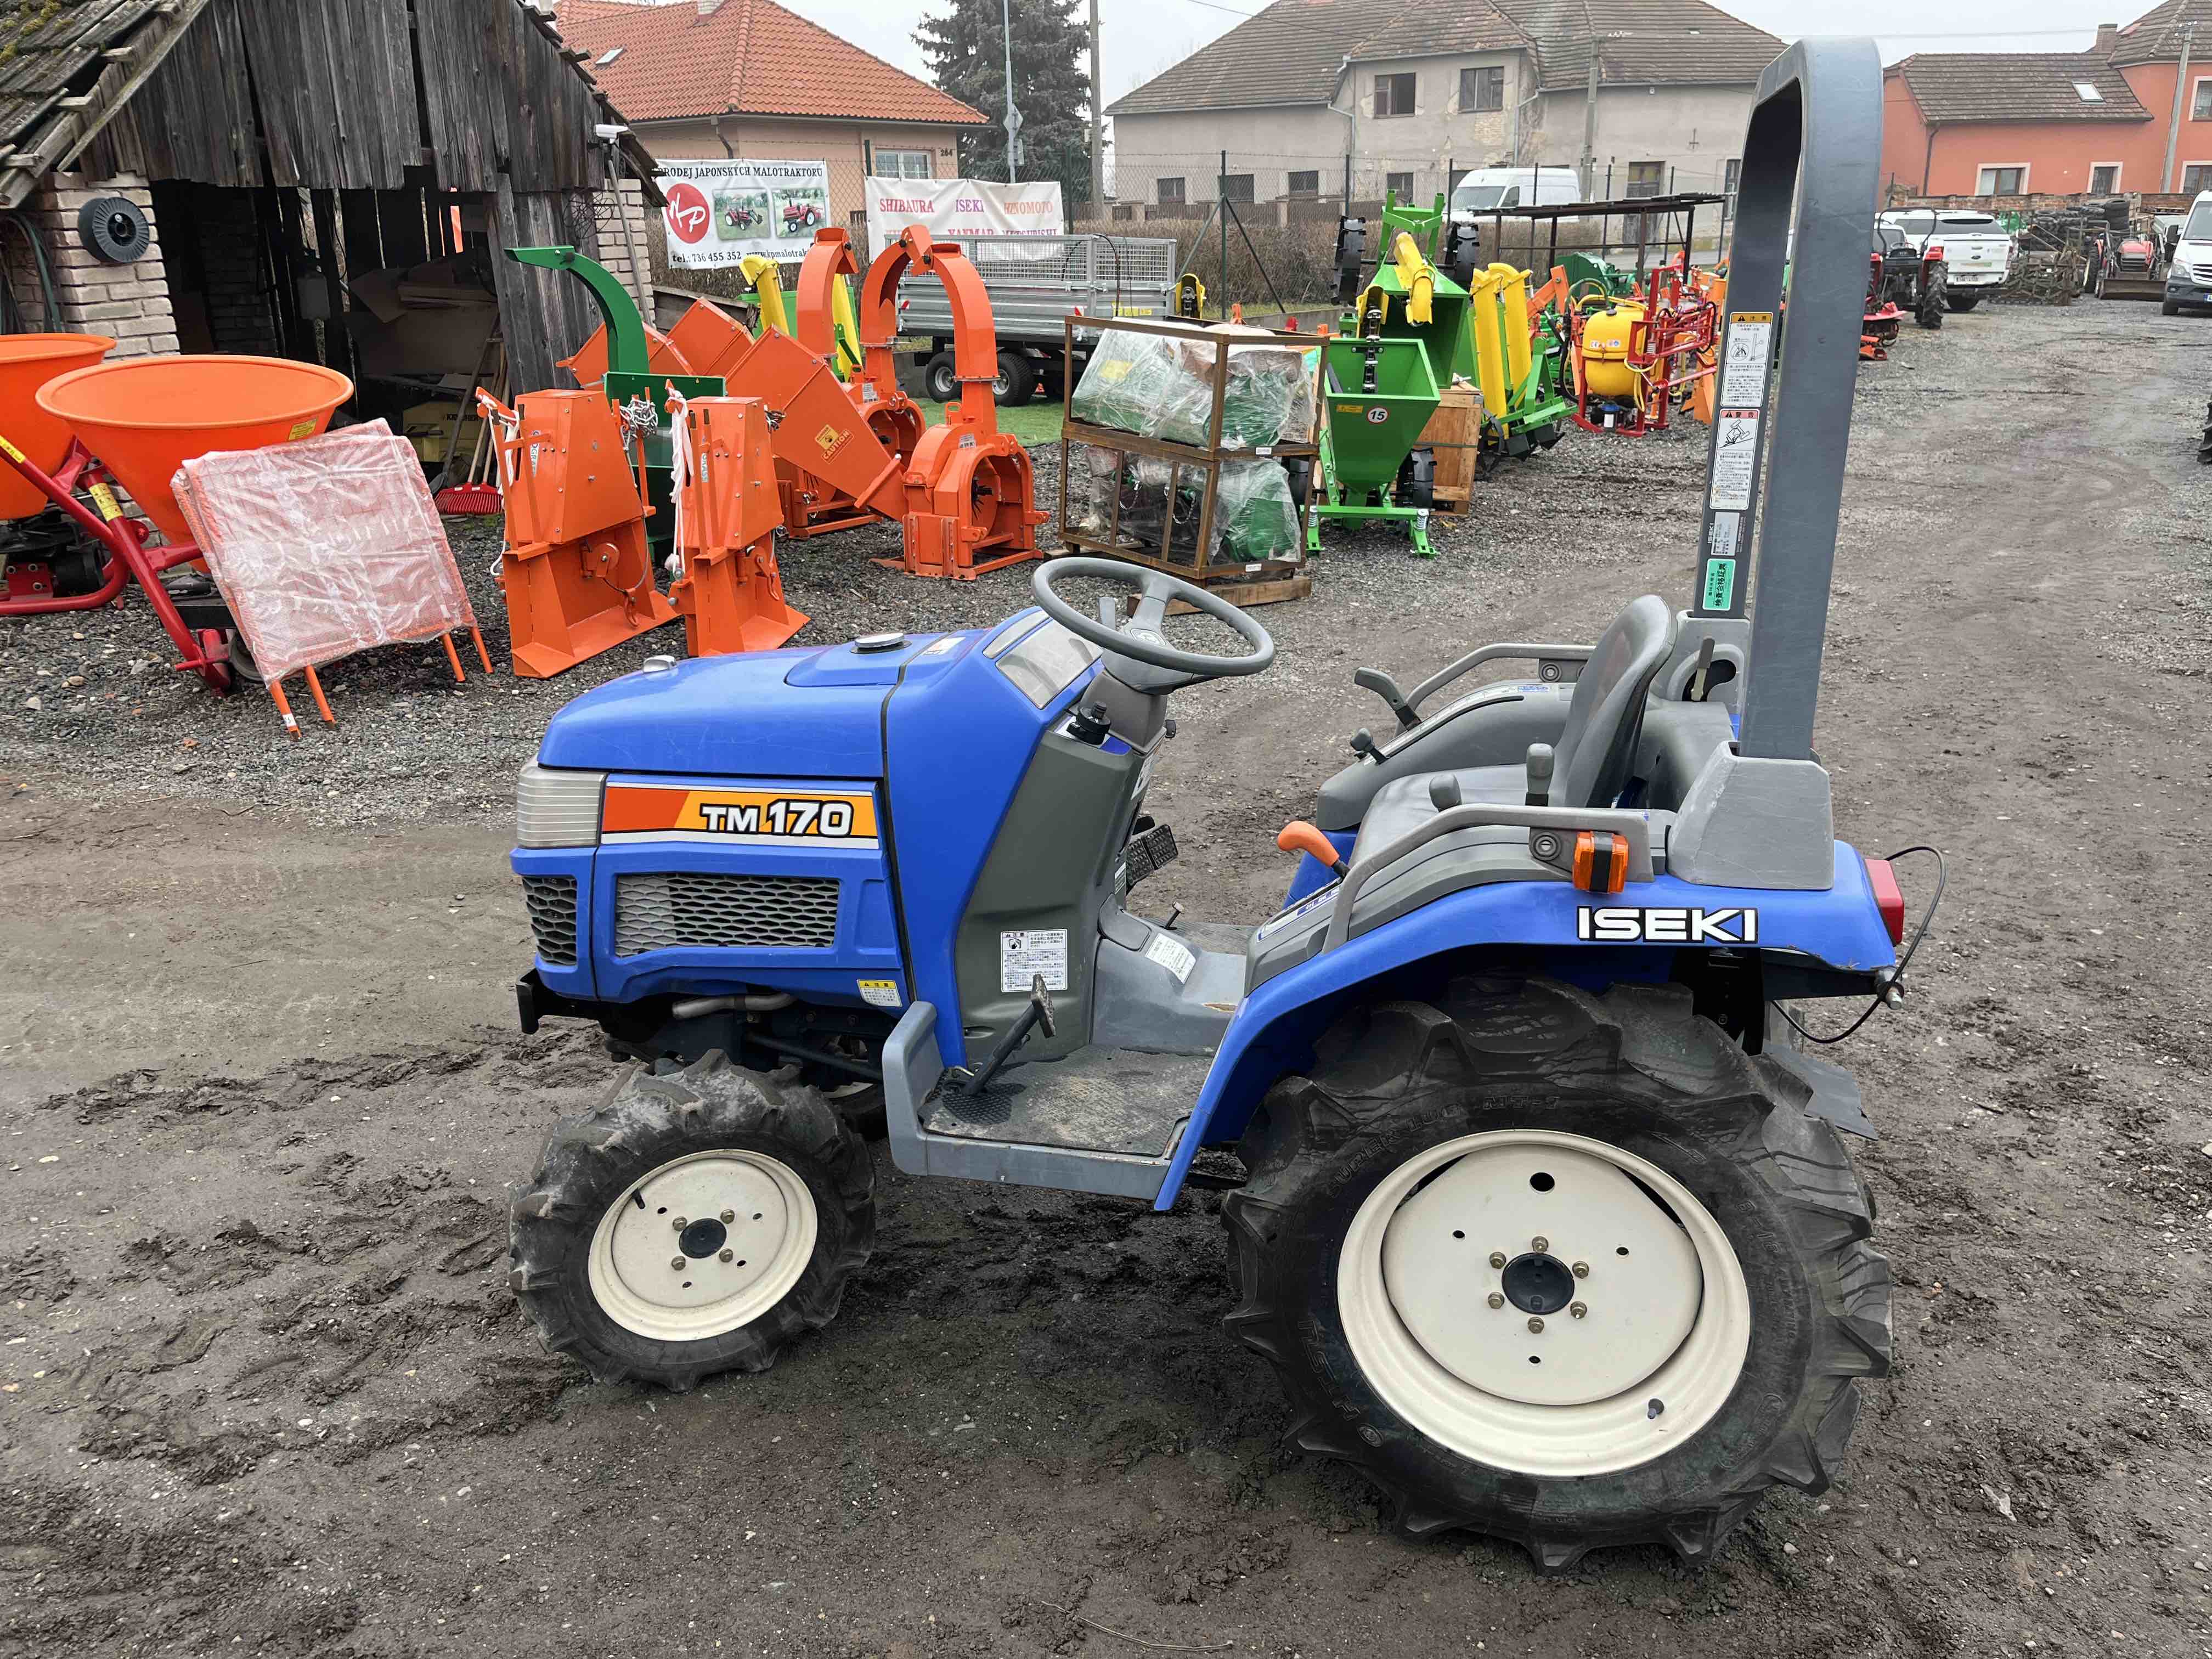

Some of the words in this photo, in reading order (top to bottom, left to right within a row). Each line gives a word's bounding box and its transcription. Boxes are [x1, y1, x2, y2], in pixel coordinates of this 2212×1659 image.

[880, 199, 935, 213] SHIBAURA
[955, 199, 984, 212] ISEKI
[692, 253, 707, 262] 736
[708, 252, 724, 261] 455
[727, 251, 742, 261] 352
[1370, 410, 1386, 420] 15
[823, 430, 850, 460] CAUTION
[1578, 906, 1759, 944] ISEKI
